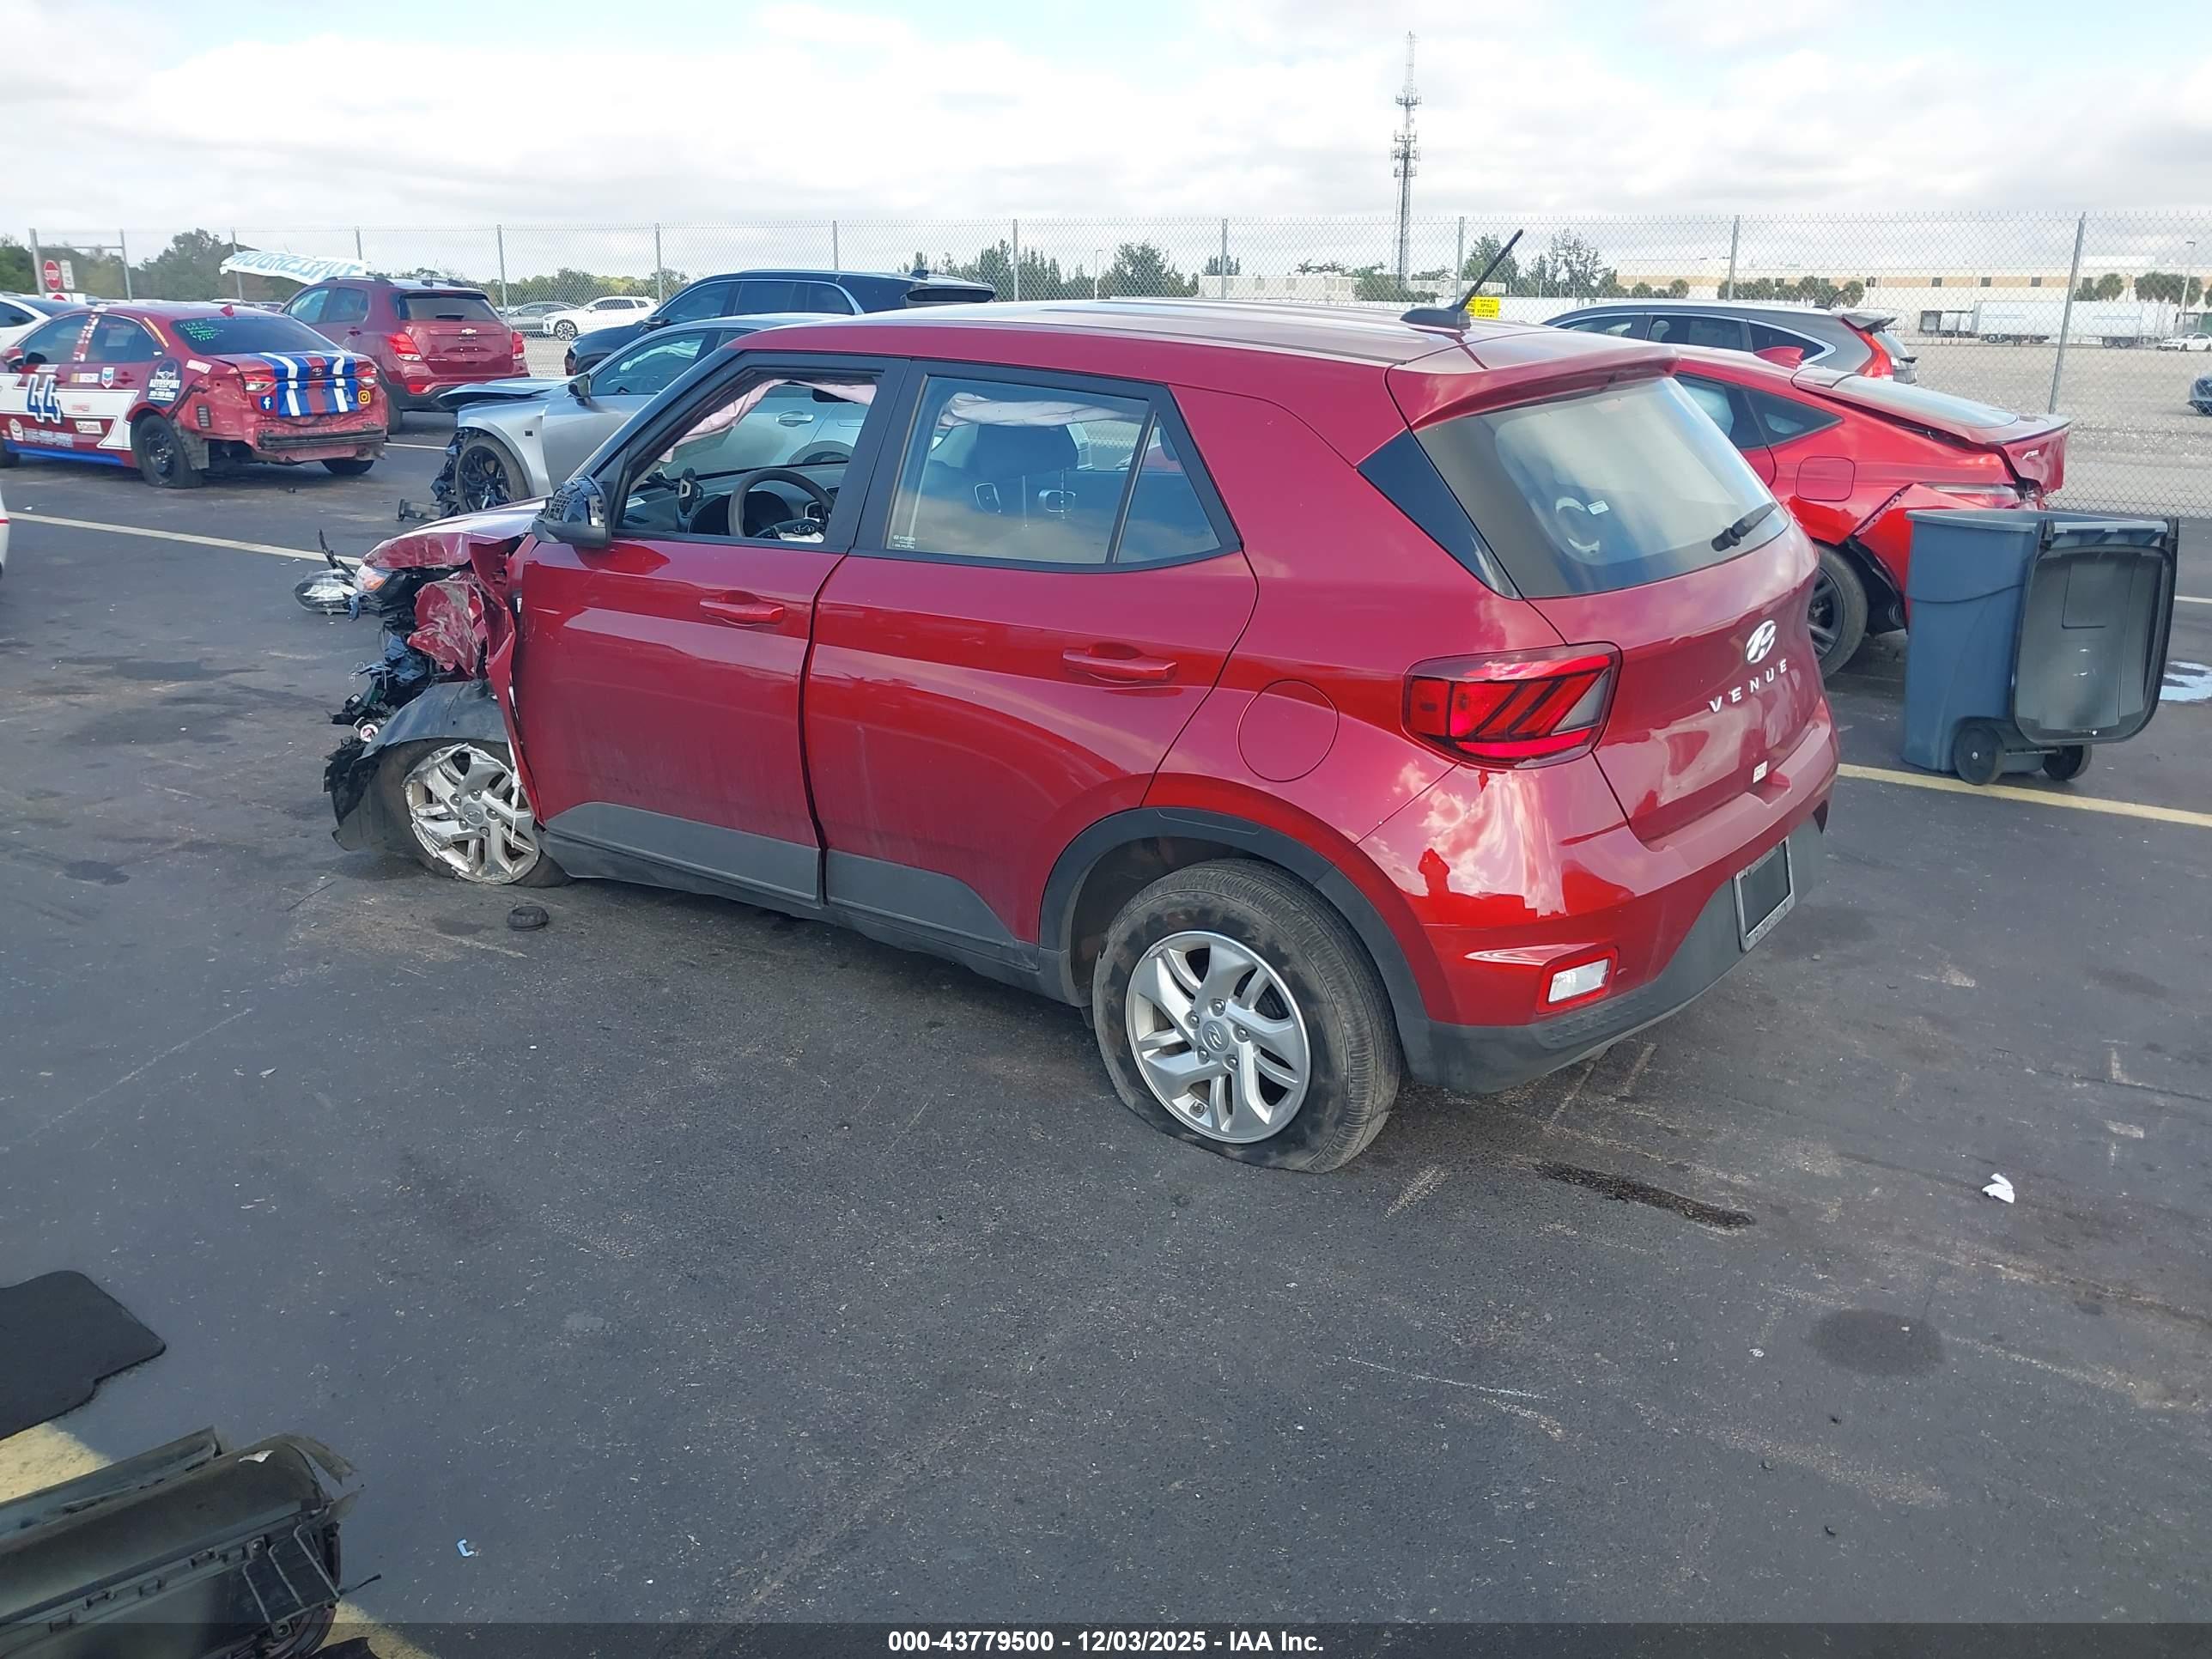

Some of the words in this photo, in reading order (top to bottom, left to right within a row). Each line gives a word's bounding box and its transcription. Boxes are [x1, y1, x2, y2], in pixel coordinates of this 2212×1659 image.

[229, 251, 361, 280] ROGRESSIVE
[27, 374, 62, 424] 44
[1708, 658, 1787, 713] VENUE
